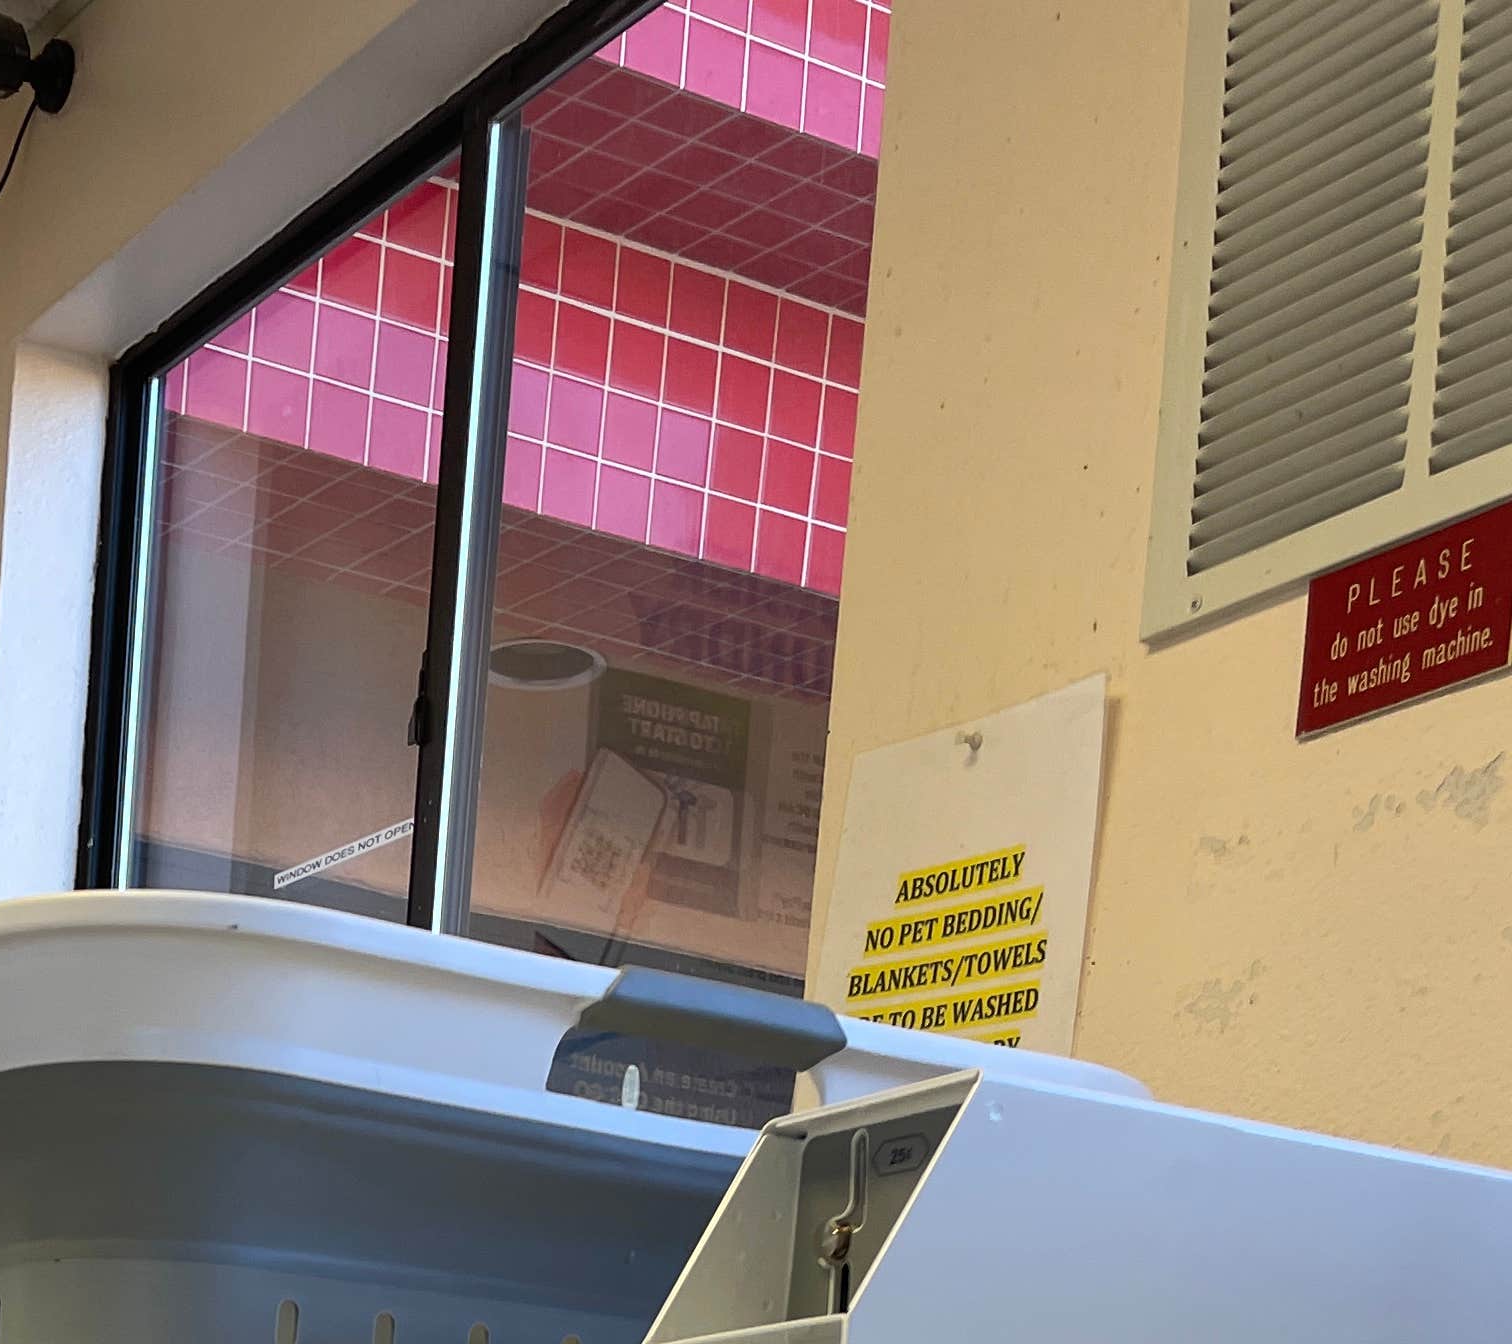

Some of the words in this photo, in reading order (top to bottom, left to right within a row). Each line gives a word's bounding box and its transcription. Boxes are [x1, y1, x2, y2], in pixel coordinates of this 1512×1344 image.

[1347, 538, 1475, 614] PLEASE
[1330, 632, 1348, 661] do
[1357, 617, 1384, 652] not
[1393, 610, 1420, 639] use
[1429, 594, 1459, 629] dye
[1468, 581, 1484, 612] in
[1313, 677, 1338, 709] the
[1347, 652, 1411, 696] washing
[1421, 623, 1494, 671] machine.
[277, 860, 322, 885] WINDOW
[324, 845, 355, 866] DOES
[357, 834, 382, 851] NOT
[895, 851, 1026, 904] ABSOLUTELY
[864, 926, 895, 952] NO
[898, 918, 938, 946] PET
[941, 892, 1044, 938] BEDDING/
[847, 939, 1048, 997] BLANKETS/TOWELS
[889, 1010, 916, 1030] TO
[920, 1004, 948, 1030] BE
[952, 988, 1039, 1024] WASHED
